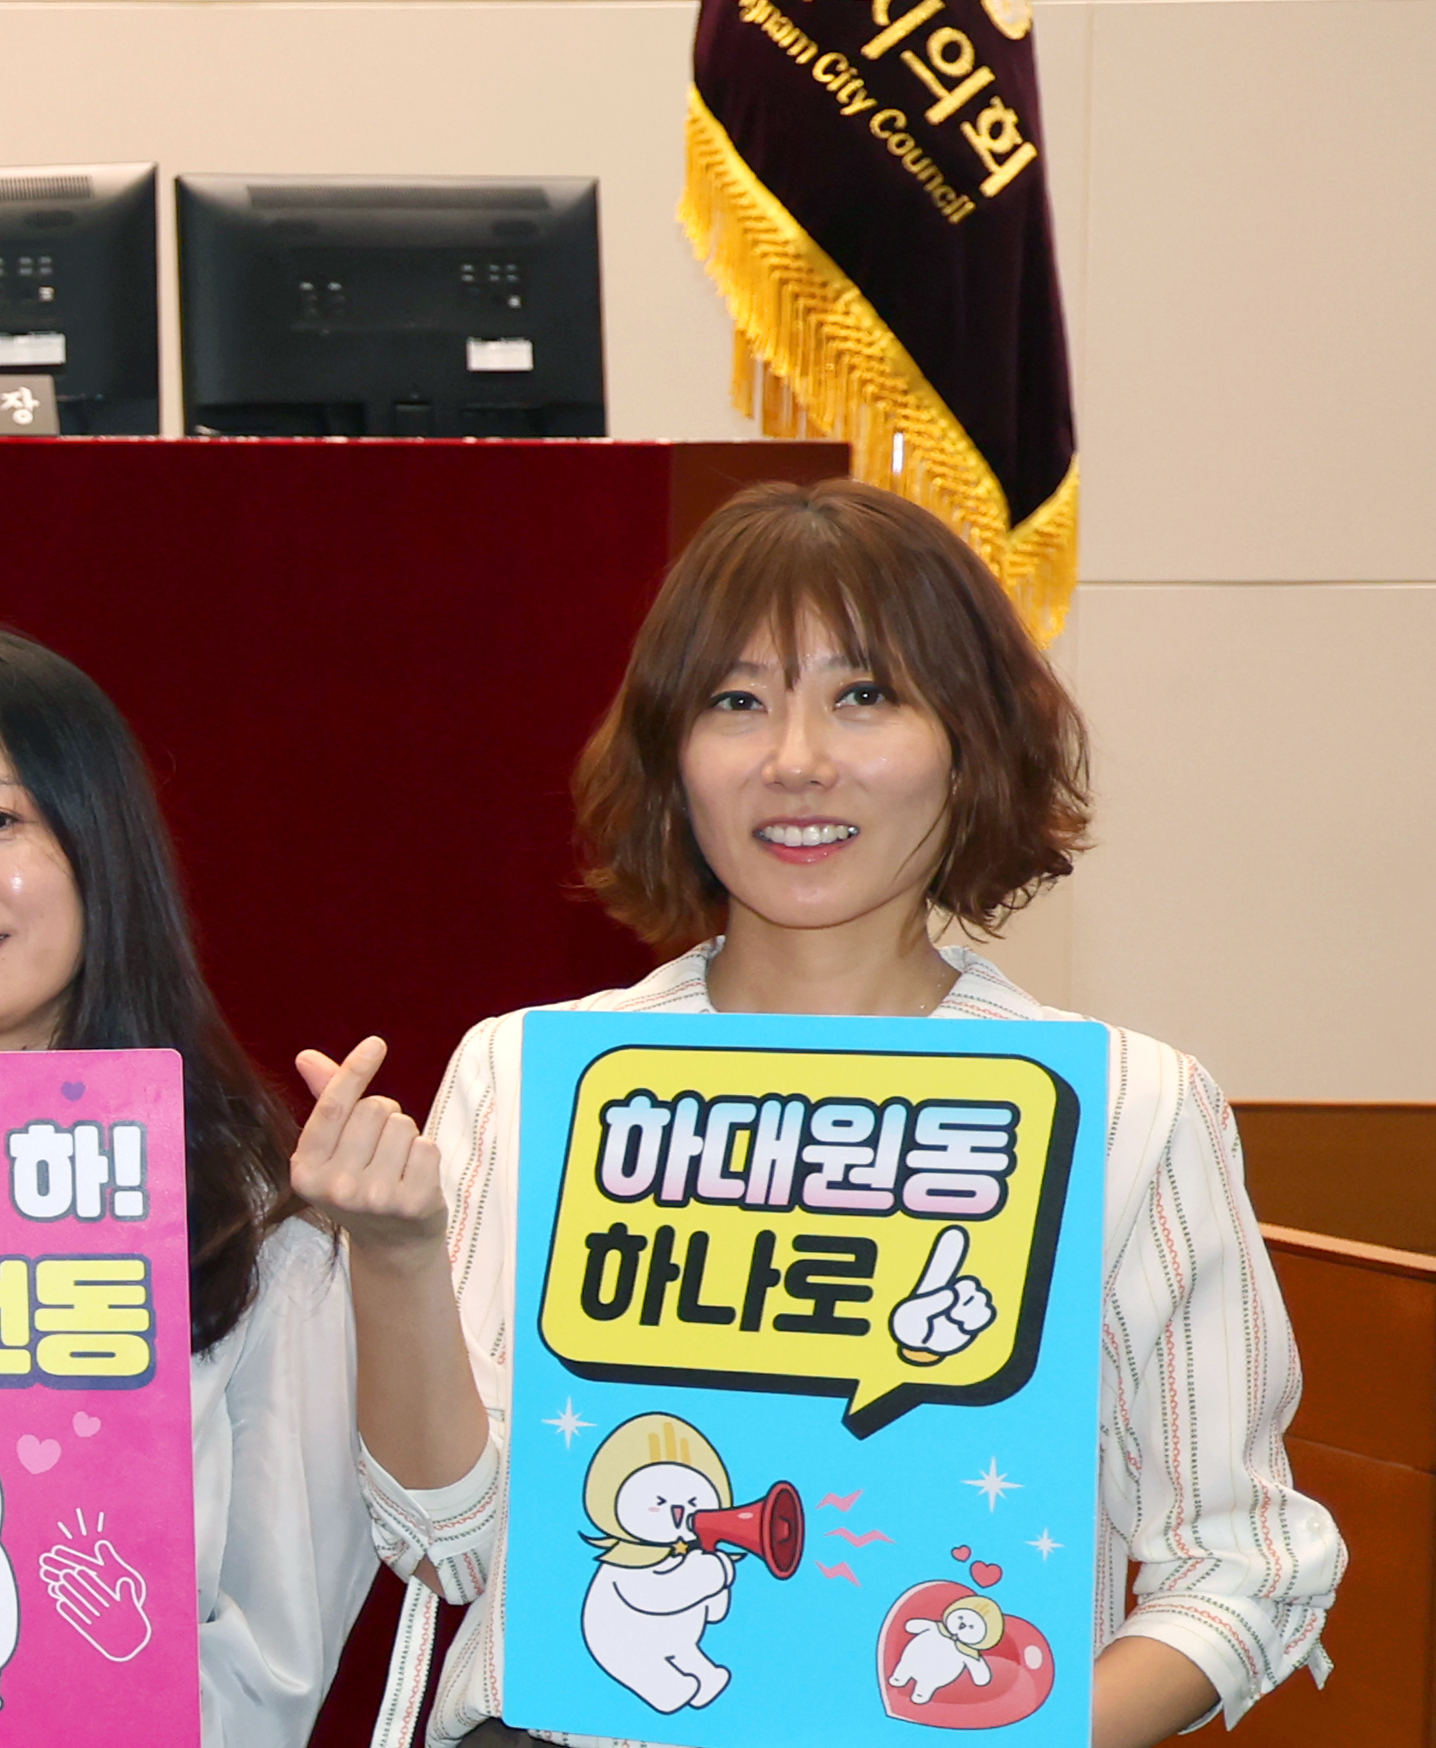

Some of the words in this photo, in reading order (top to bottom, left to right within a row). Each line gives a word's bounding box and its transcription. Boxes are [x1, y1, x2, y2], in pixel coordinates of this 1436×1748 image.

[812, 52, 878, 116] City
[869, 108, 976, 224] Council
[8, 1122, 146, 1219] 하!
[598, 1094, 1015, 1218] 하대원동
[580, 1222, 880, 1337] 하나로
